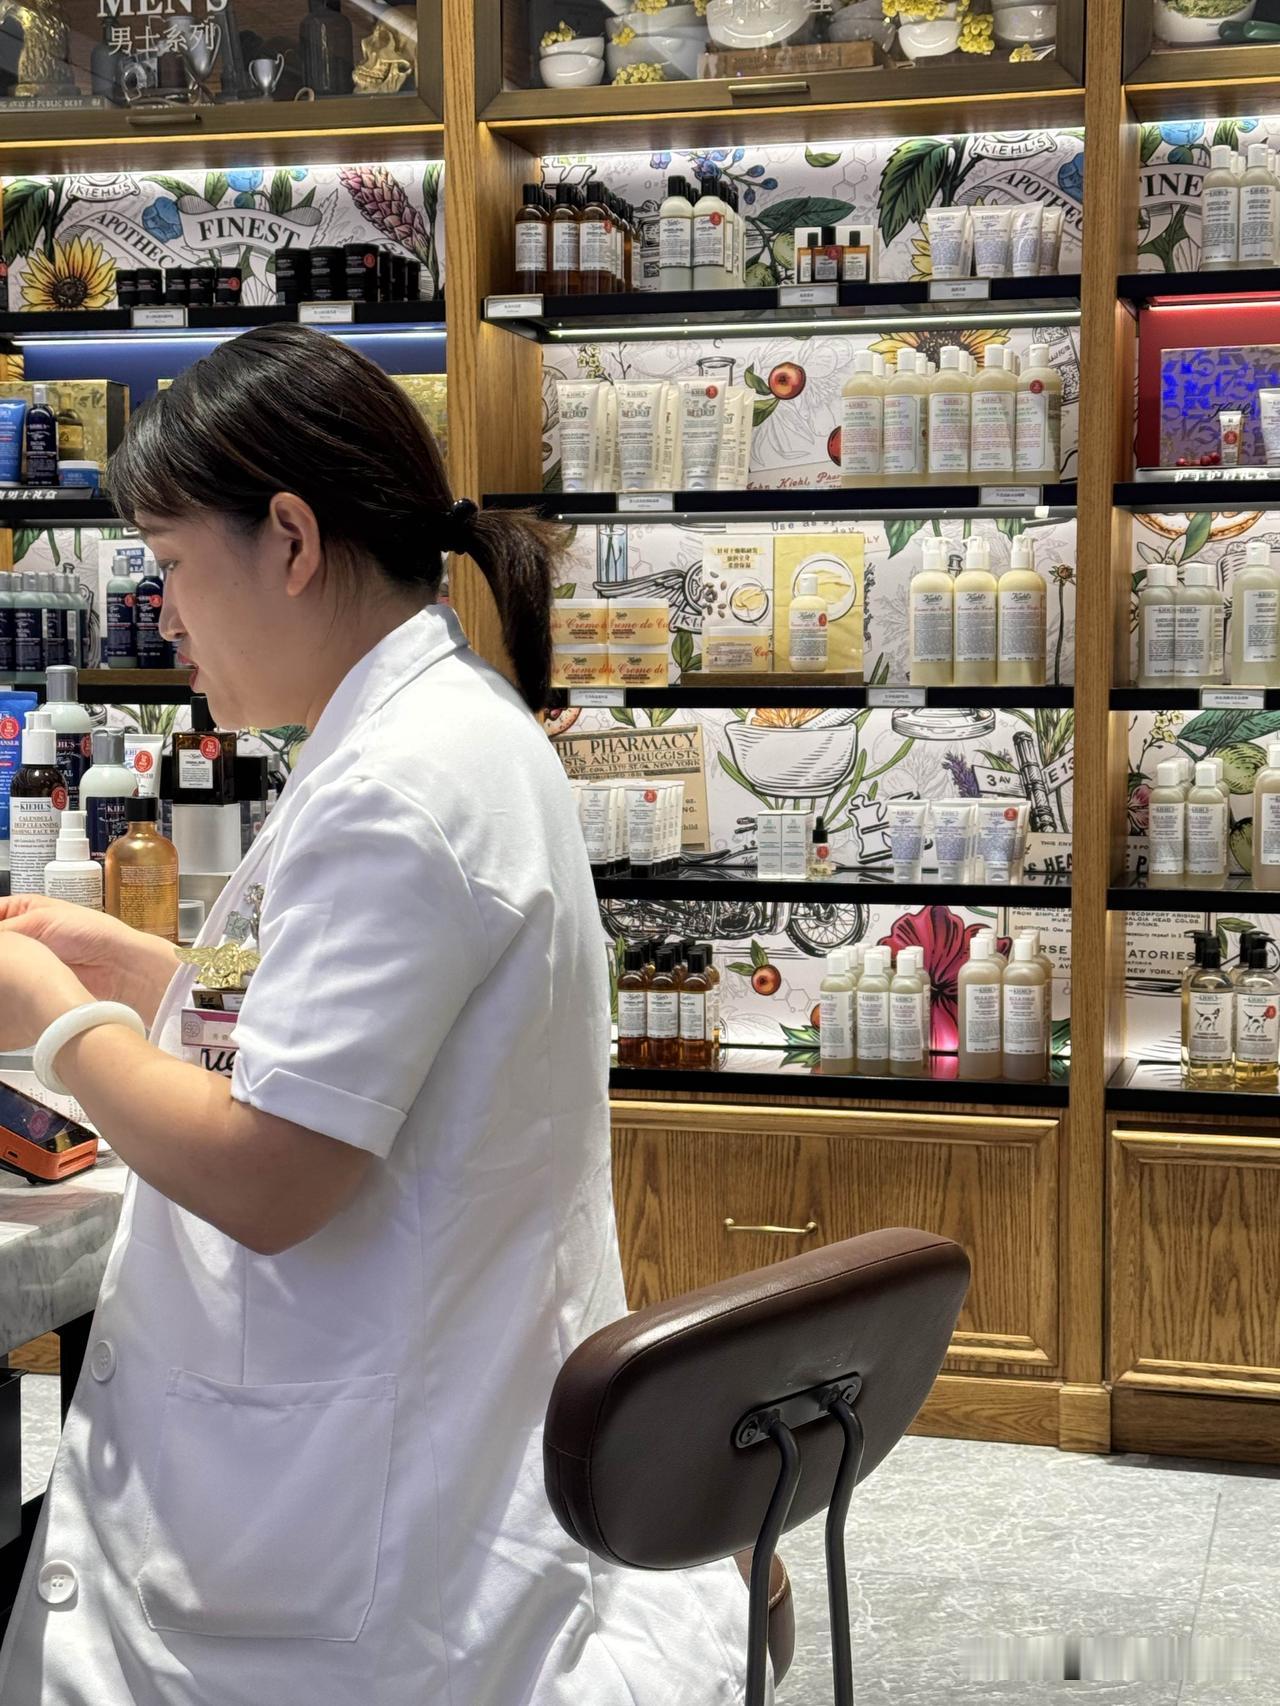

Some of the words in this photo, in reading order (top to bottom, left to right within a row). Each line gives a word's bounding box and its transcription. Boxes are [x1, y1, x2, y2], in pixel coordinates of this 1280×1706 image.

[97, 0, 228, 17] MENS
[109, 24, 215, 57] 男士系列
[980, 138, 1047, 156] KIEHL'S
[76, 183, 132, 198] KIEHL'S
[1139, 172, 1204, 198] INE
[91, 212, 183, 269] APOTHEC
[197, 216, 301, 249] FINEST
[771, 522, 795, 532] Use
[590, 733, 697, 754] PHARMACY
[591, 753, 620, 765] AND
[628, 749, 700, 763] DRUGGISTS
[653, 761, 674, 769] NEW
[676, 760, 700, 768] YORK
[986, 774, 997, 787] 3
[999, 775, 1011, 784] AV
[1047, 768, 1060, 784] E
[1127, 949, 1197, 961] ATORIES
